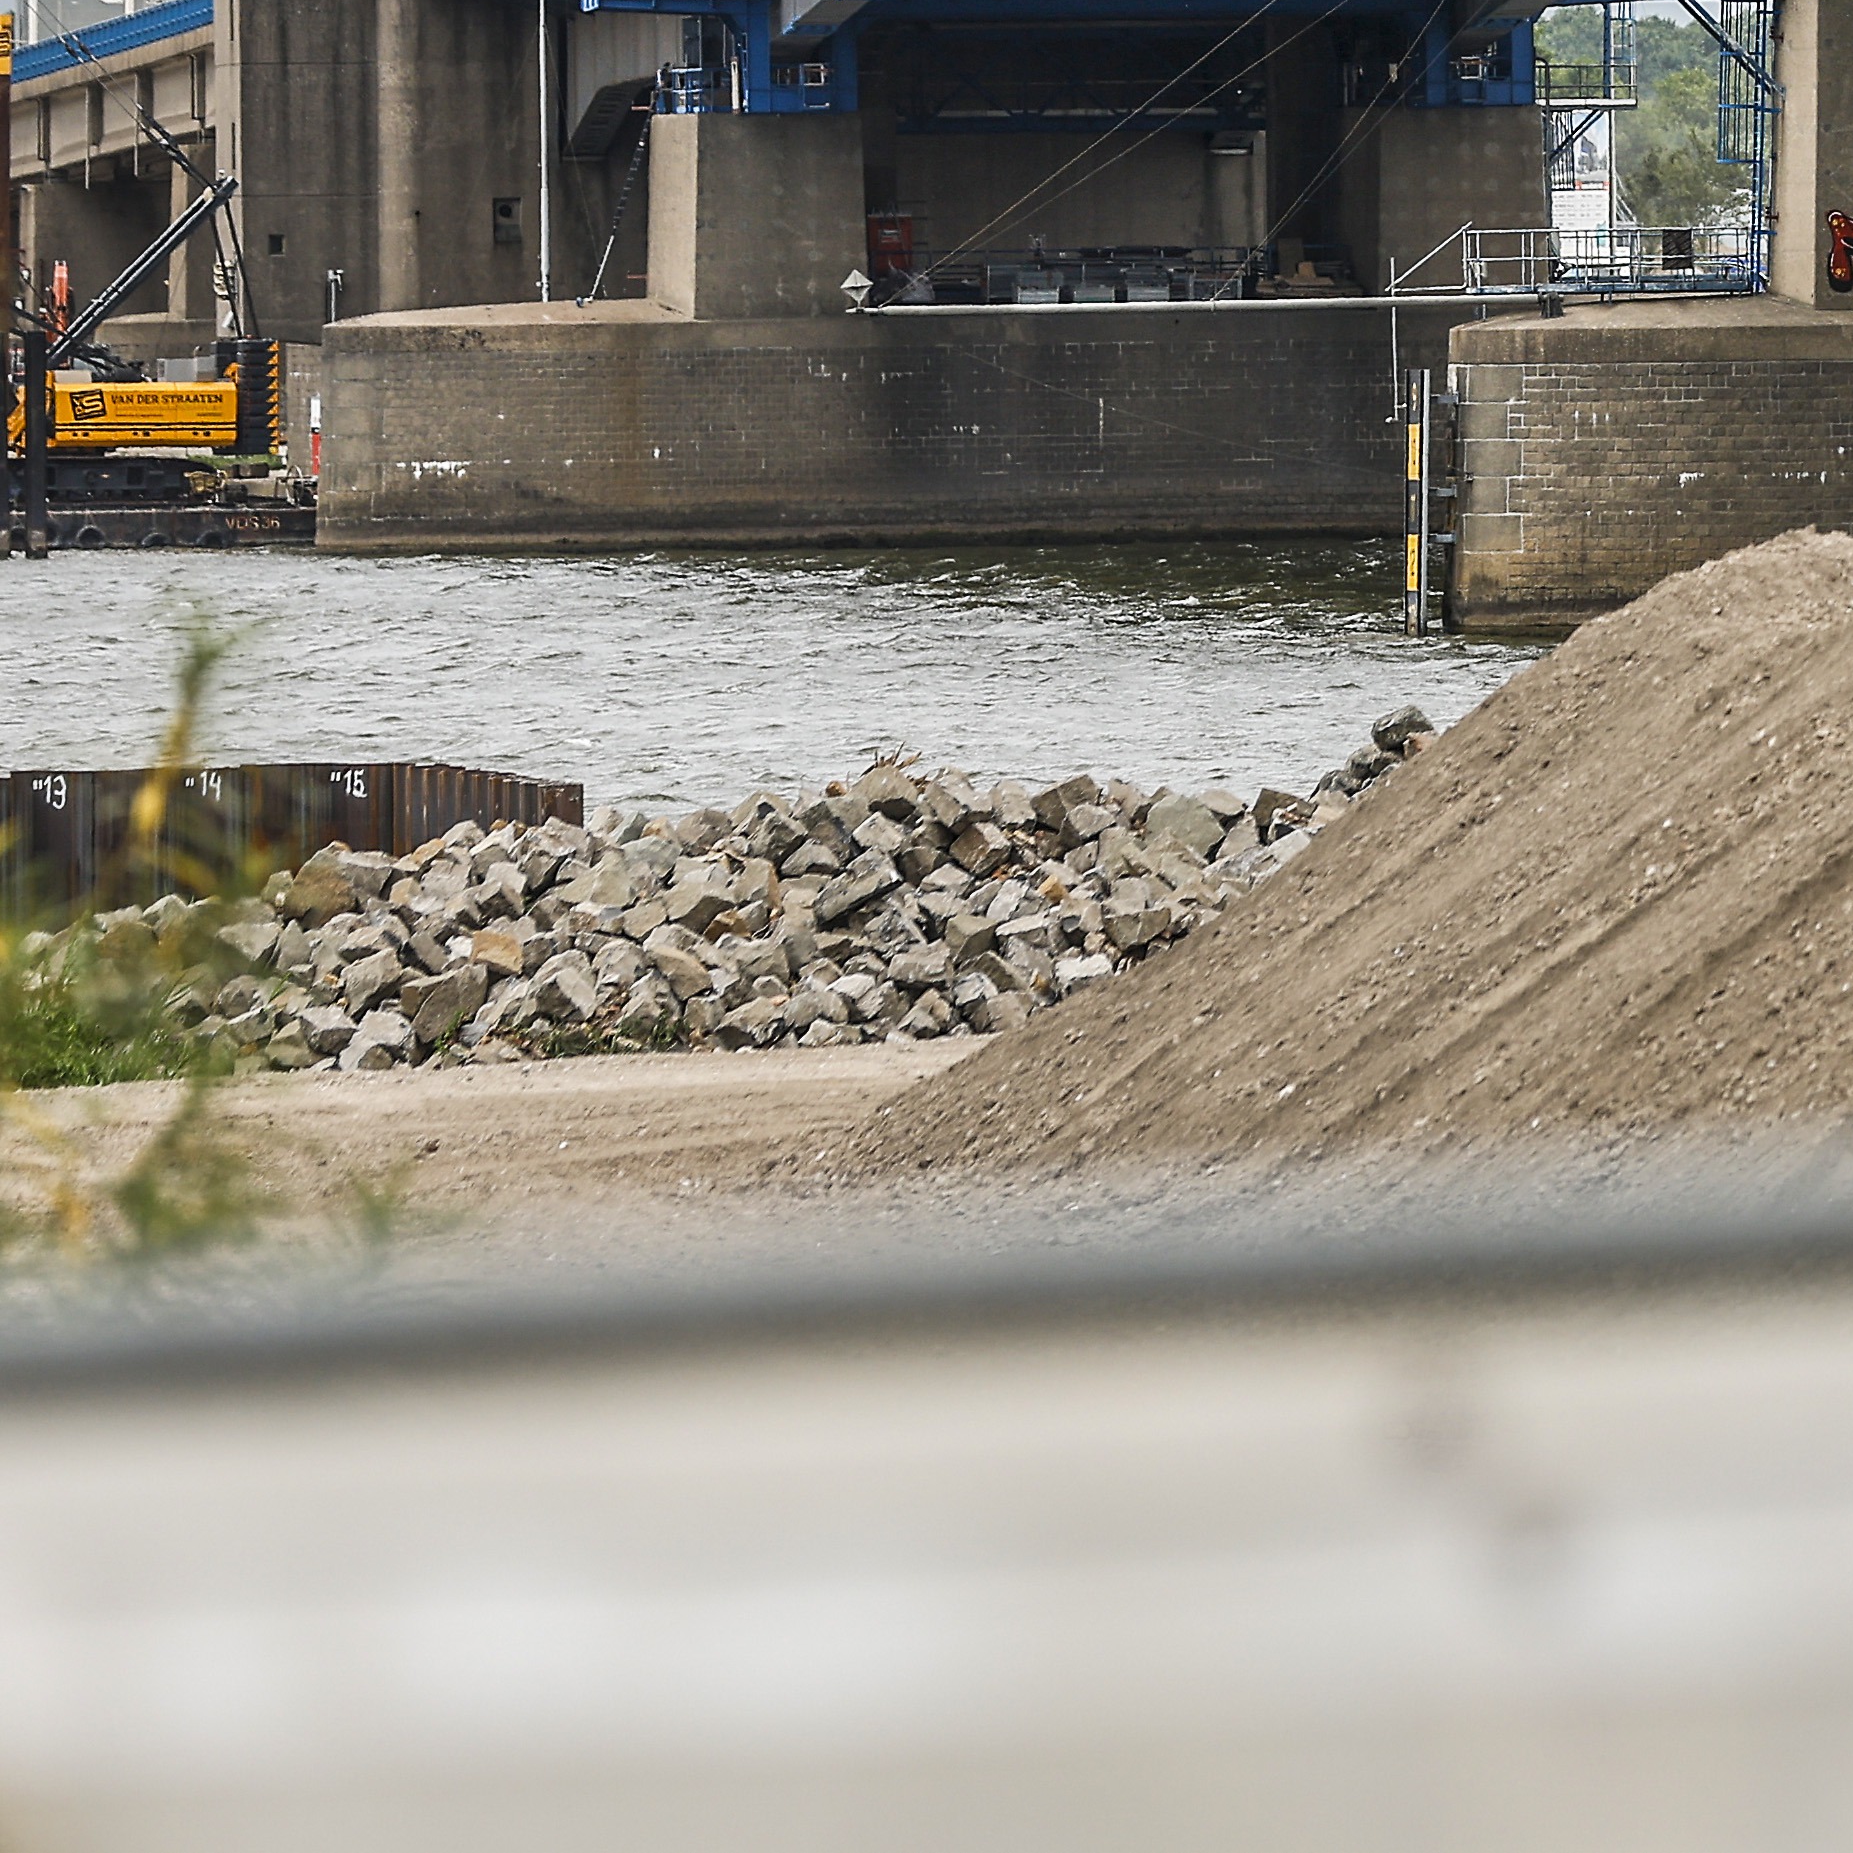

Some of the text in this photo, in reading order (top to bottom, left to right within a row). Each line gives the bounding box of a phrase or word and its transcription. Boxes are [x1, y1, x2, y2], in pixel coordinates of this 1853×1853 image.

[111, 393, 223, 405] VAN DER STRAATEN
